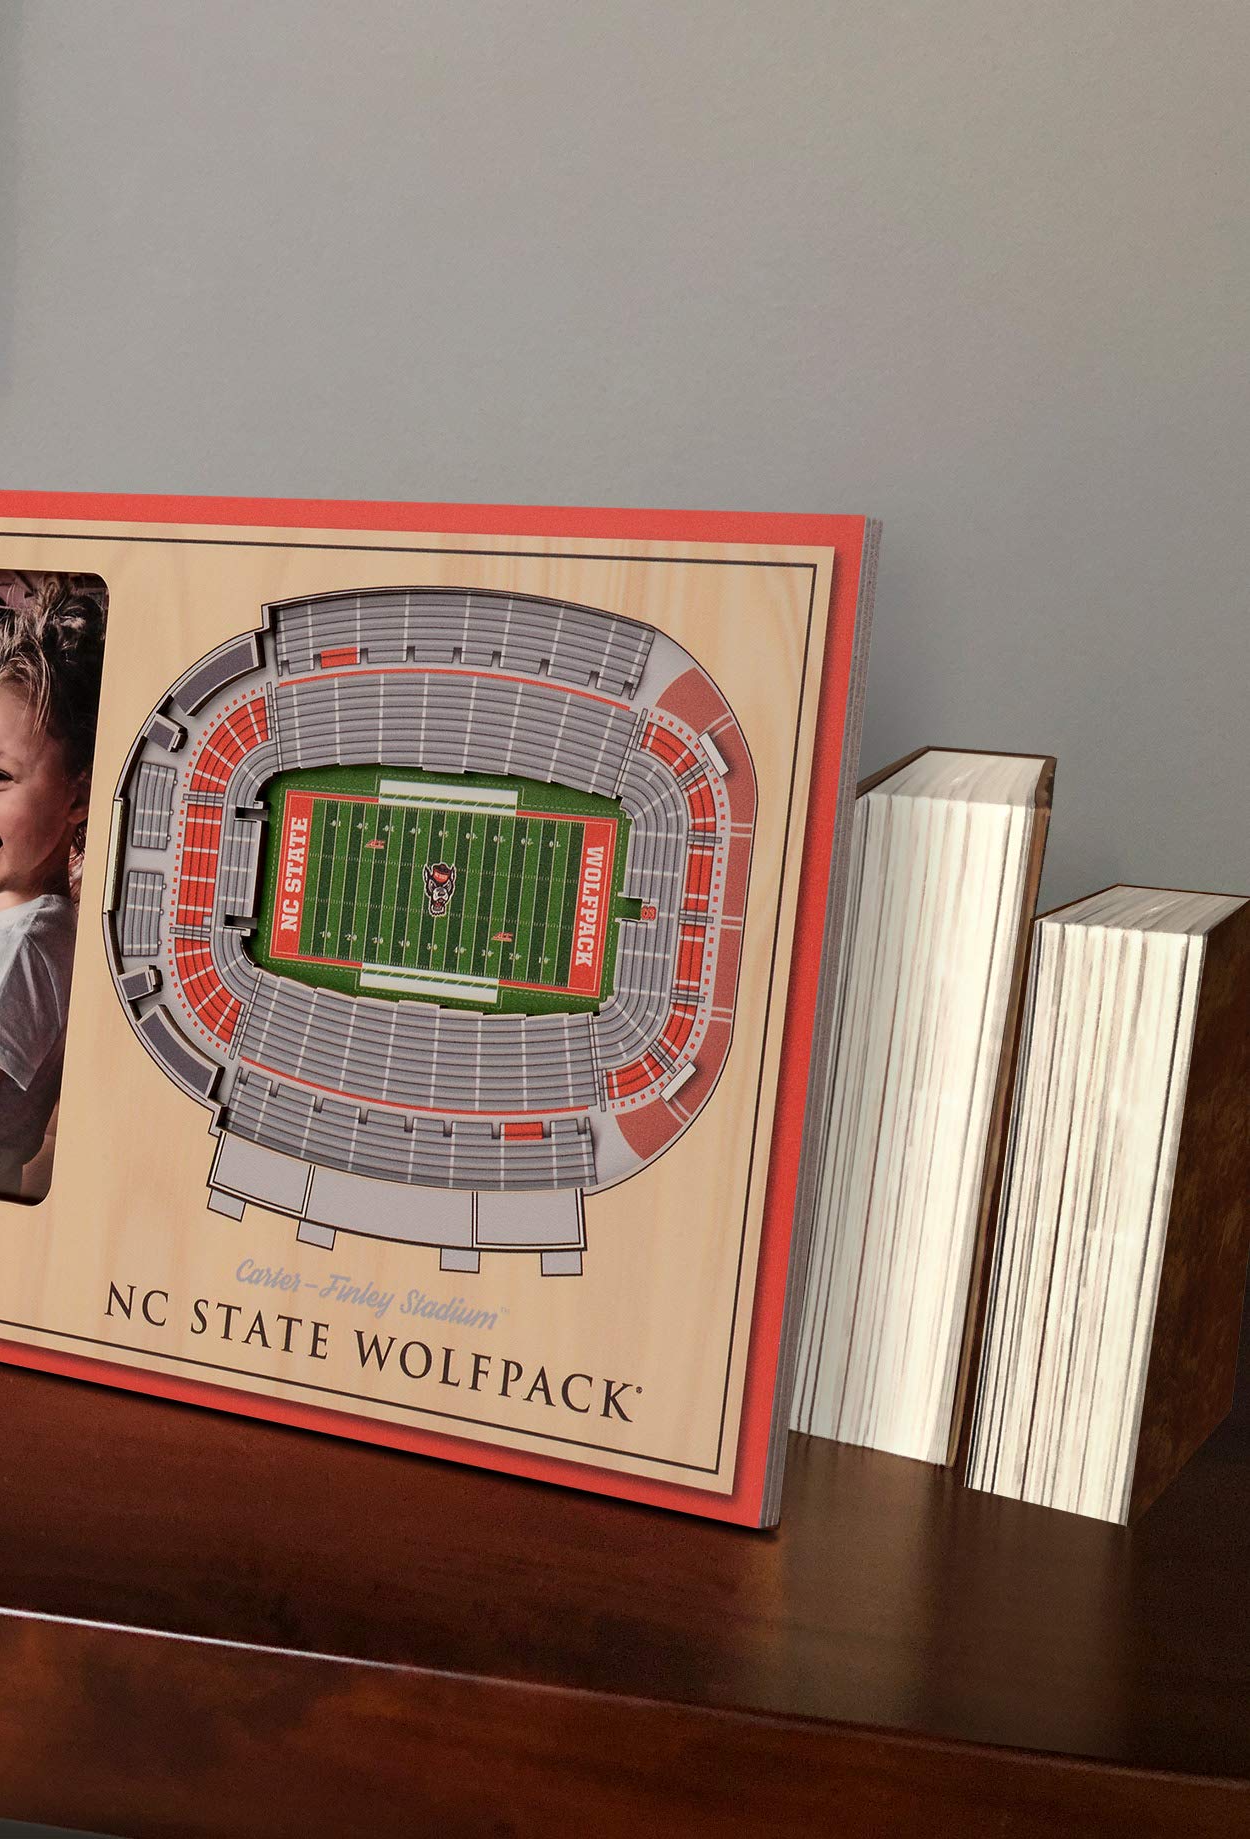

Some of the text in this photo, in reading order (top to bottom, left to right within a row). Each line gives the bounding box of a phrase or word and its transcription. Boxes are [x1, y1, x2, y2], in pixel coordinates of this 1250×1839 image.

[280, 817, 308, 932] NC STATE
[575, 846, 605, 967] WOLFPACK
[104, 1281, 169, 1327] NC
[190, 1298, 330, 1360] STATE
